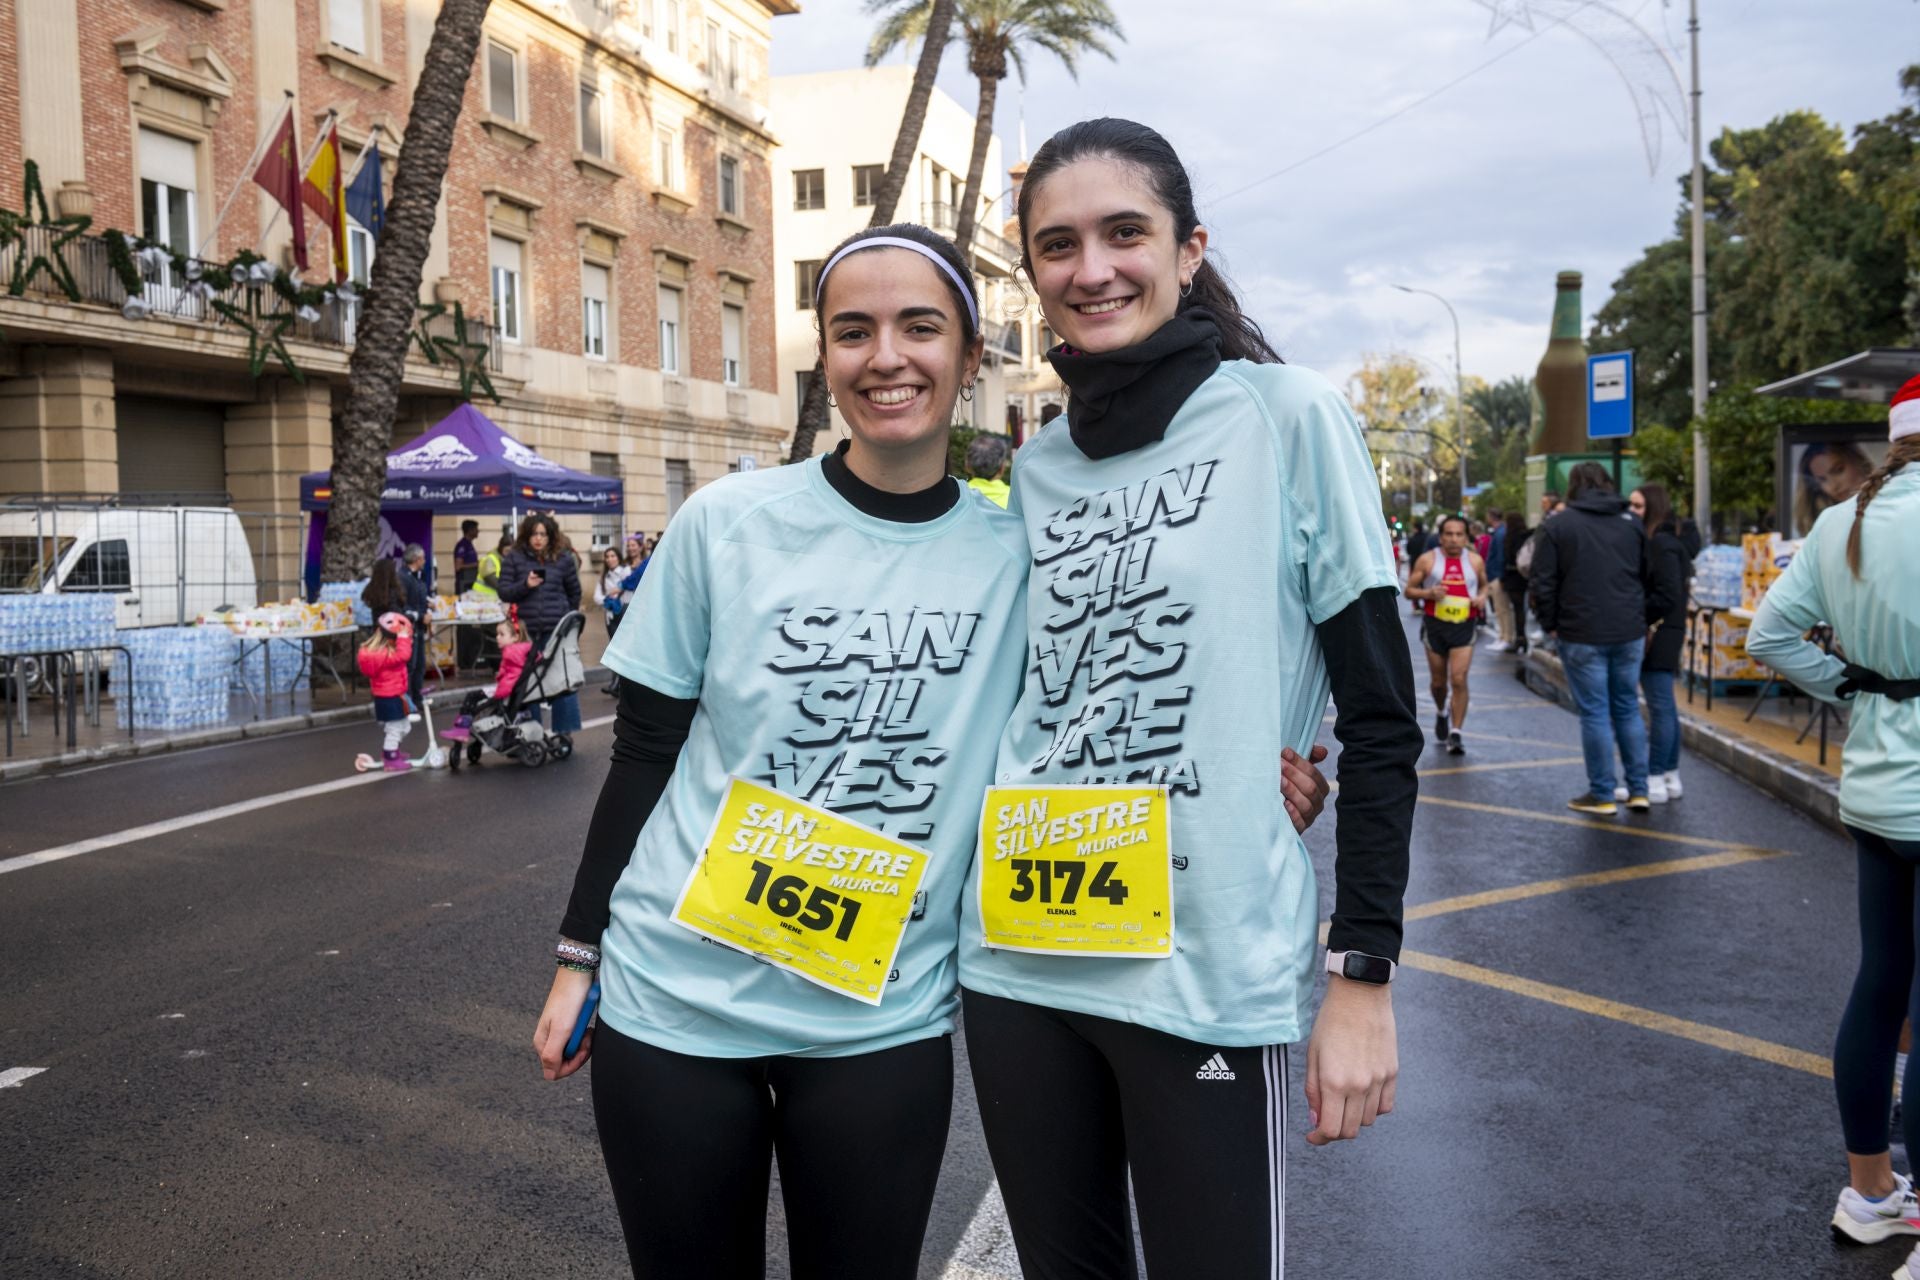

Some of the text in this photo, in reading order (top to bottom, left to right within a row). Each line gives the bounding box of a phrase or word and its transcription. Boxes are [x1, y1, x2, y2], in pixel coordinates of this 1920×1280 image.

[1033, 459, 1222, 565] SAN
[1042, 537, 1168, 634] SIL
[764, 605, 983, 675] SAN
[1030, 603, 1193, 708] VES
[784, 671, 930, 748] SIL
[1030, 686, 1194, 774] TRE
[757, 746, 949, 814] VES
[740, 801, 818, 840] SAN
[994, 796, 1152, 861] SILVESTRE
[996, 797, 1049, 832] SAN
[1076, 828, 1149, 857] MURCIA
[727, 828, 915, 880] SILVESTRE
[1009, 858, 1128, 905] 3174
[745, 860, 863, 942] 1651
[828, 873, 899, 897] MURCIA
[1046, 908, 1077, 916] ELENAIS
[779, 921, 803, 936] IRENE
[1196, 1069, 1236, 1080] adidas
